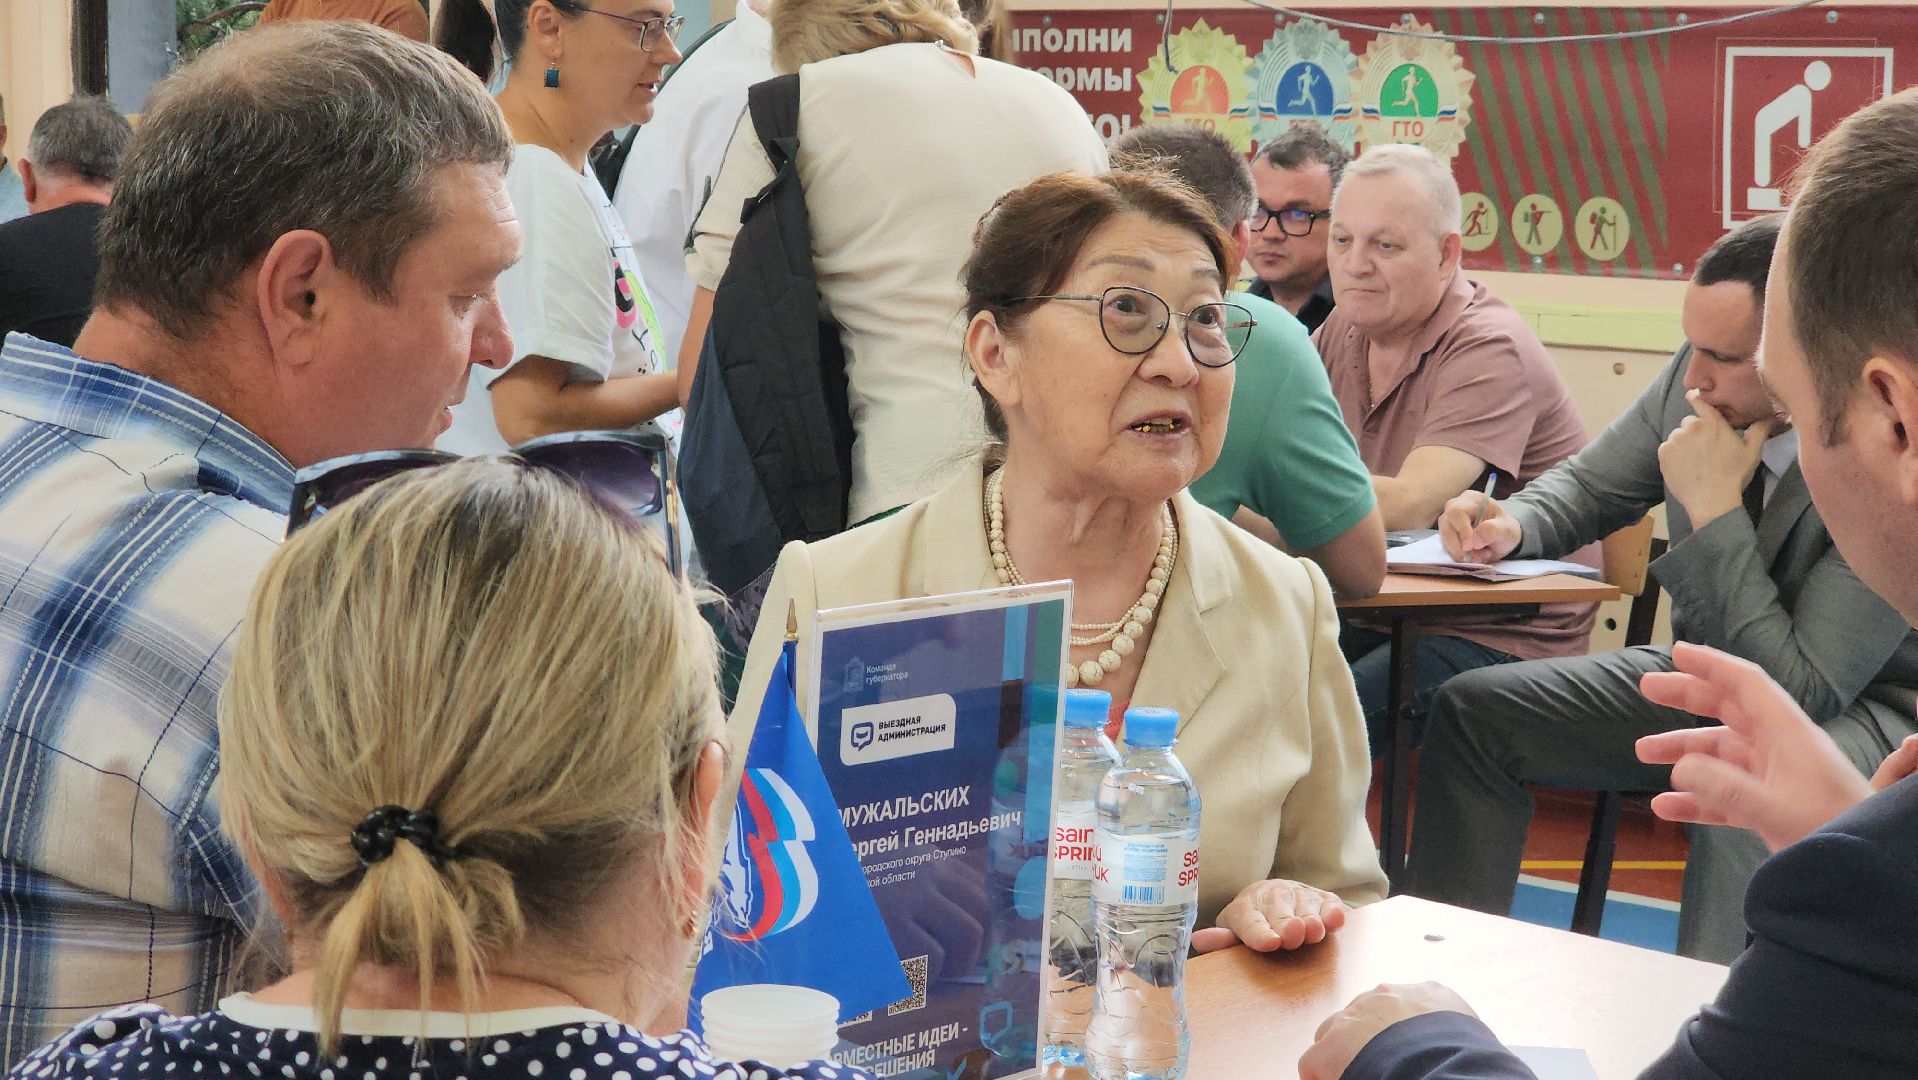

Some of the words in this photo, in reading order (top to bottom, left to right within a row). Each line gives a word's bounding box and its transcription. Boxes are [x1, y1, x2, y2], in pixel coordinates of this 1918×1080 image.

[1025, 66, 1132, 92] рмы
[1392, 120, 1424, 137] ГТО
[866, 663, 897, 674] Команда
[866, 671, 909, 685] губернатора
[878, 716, 921, 730] ВЫЕЗДНАЯ
[878, 724, 946, 742] АДМИНИСТРАЦИЯ
[838, 785, 970, 828] МУЖАЛЬСКИХ
[904, 811, 1022, 848] Геннадьевич
[905, 854, 931, 868] округа
[933, 845, 967, 861] Ступино
[881, 870, 916, 885] области
[918, 1022, 959, 1050] ИДЕИ
